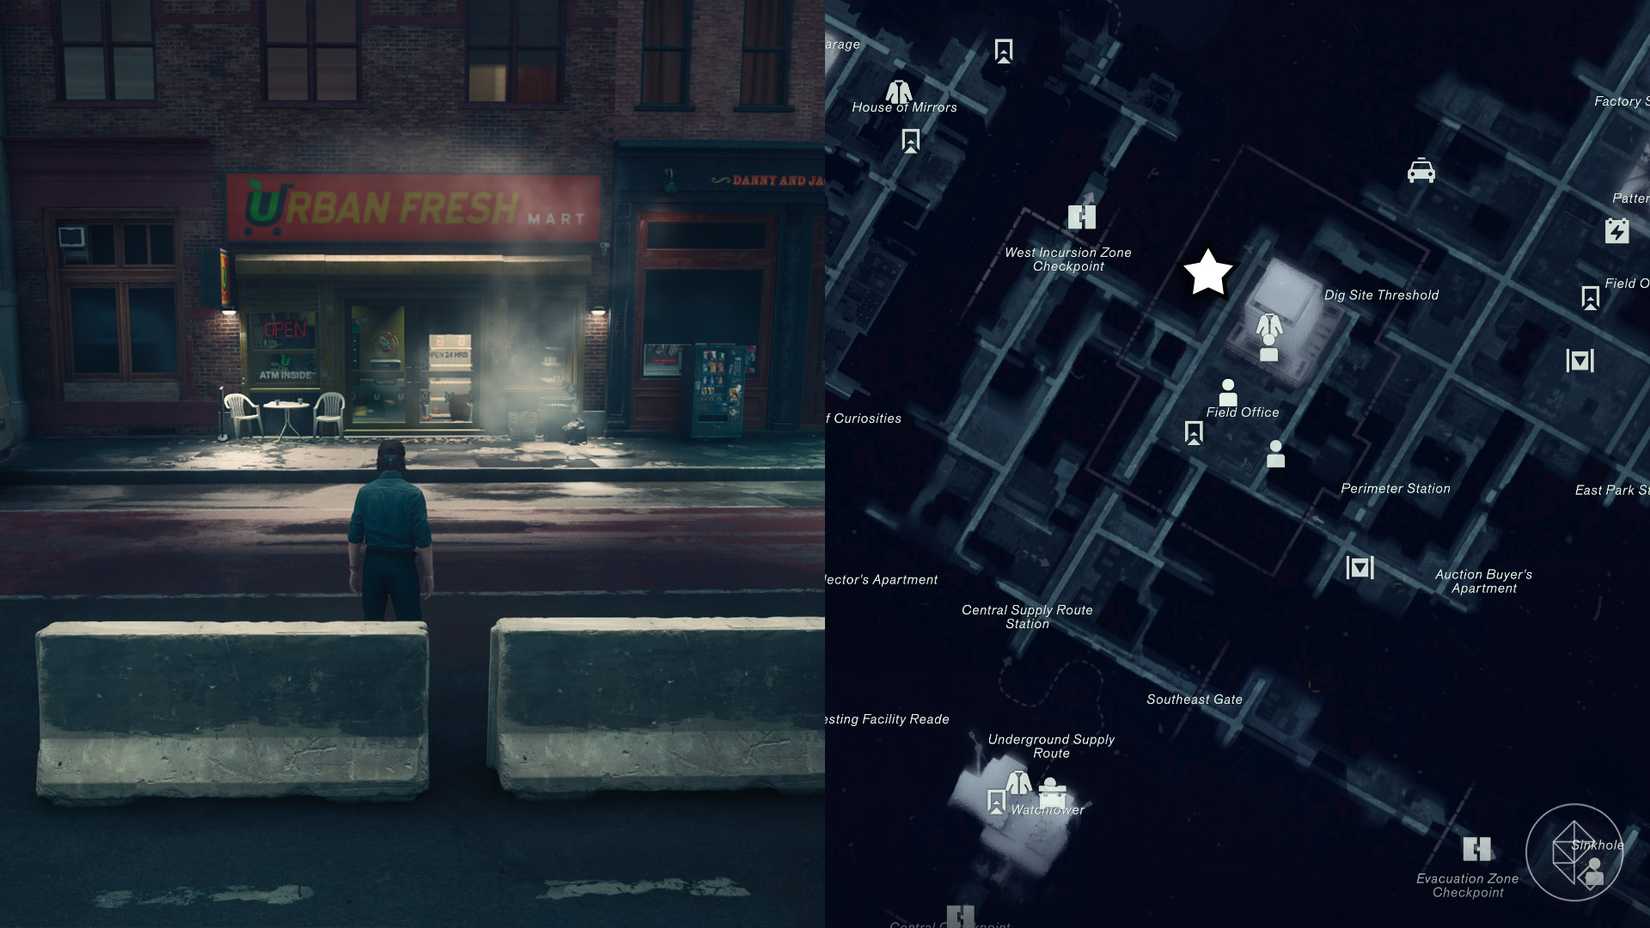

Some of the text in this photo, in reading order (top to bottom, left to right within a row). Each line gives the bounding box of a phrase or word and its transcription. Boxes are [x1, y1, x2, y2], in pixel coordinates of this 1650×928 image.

[825, 40, 860, 51] arage
[852, 102, 957, 113] House of Mirrors
[1594, 96, 1640, 108] Factory
[732, 176, 825, 186] DANNY AND JA
[244, 179, 585, 236] URBAN FRESH MART
[1005, 247, 1131, 258] West Incursion Zone
[1033, 260, 1104, 273] Checkpoint
[1605, 278, 1637, 289] Field
[1324, 289, 1439, 302] Dig Site Threshold
[263, 320, 307, 336] OPEN
[259, 371, 312, 379] ATM INSIDE
[1206, 407, 1279, 418] Field Office
[835, 413, 901, 424] Curiosities
[1341, 483, 1450, 493] Perimeter Station
[1575, 485, 1603, 496] East
[1606, 485, 1634, 496] Park
[873, 574, 937, 588] Apartment
[1435, 569, 1532, 582] Auction Buyer's
[1451, 583, 1517, 596] Apartment
[962, 604, 1093, 618] Central Supply Route
[1006, 618, 1049, 629] Station
[1146, 694, 1242, 705] Southeast Gate
[863, 714, 906, 727] Facility
[910, 714, 949, 724] Reade
[988, 734, 1115, 747] Underground Supply
[1033, 748, 1070, 758] Route
[1571, 840, 1624, 850] Sinkhole
[1416, 873, 1519, 884] Evacuation Zone
[1432, 887, 1504, 900] Checkpoint
